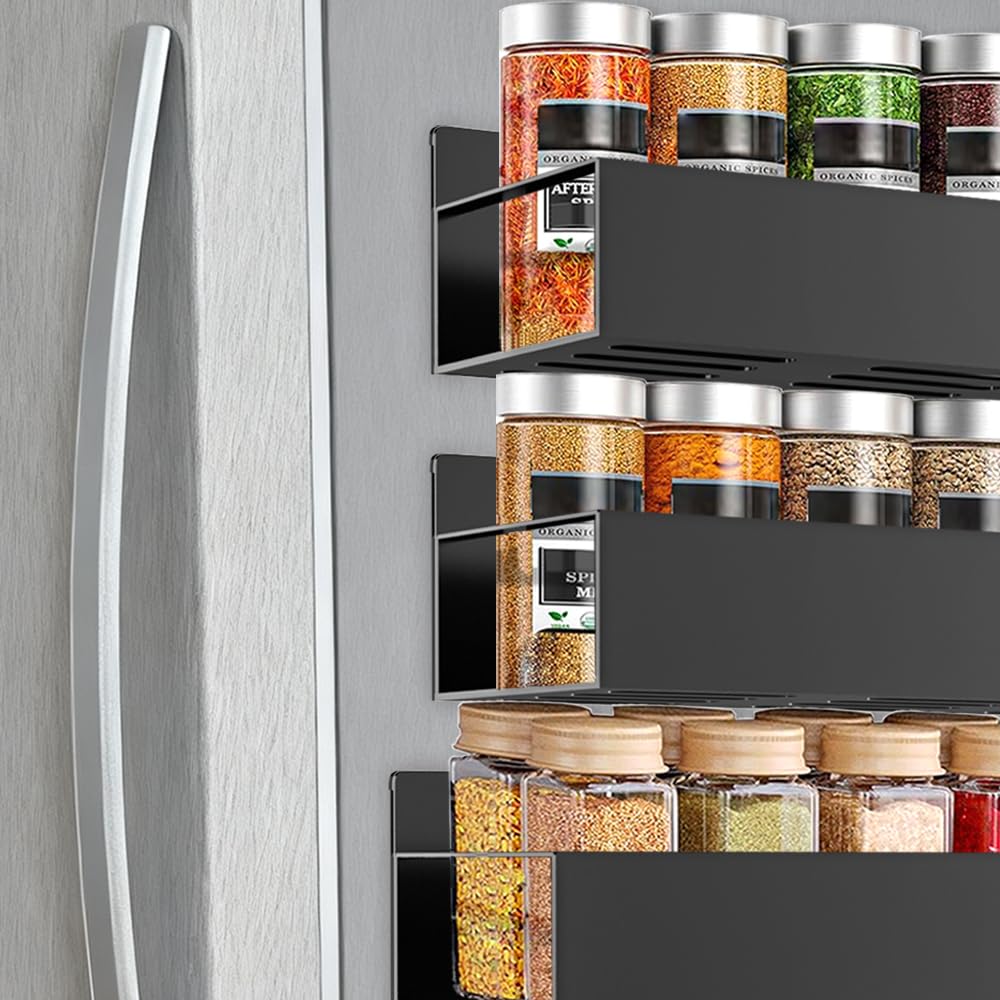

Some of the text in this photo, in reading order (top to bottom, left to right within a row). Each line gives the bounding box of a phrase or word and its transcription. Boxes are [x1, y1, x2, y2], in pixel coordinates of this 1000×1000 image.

[543, 154, 593, 164] ORGAN
[819, 172, 913, 184] ORGANIC SPICES
